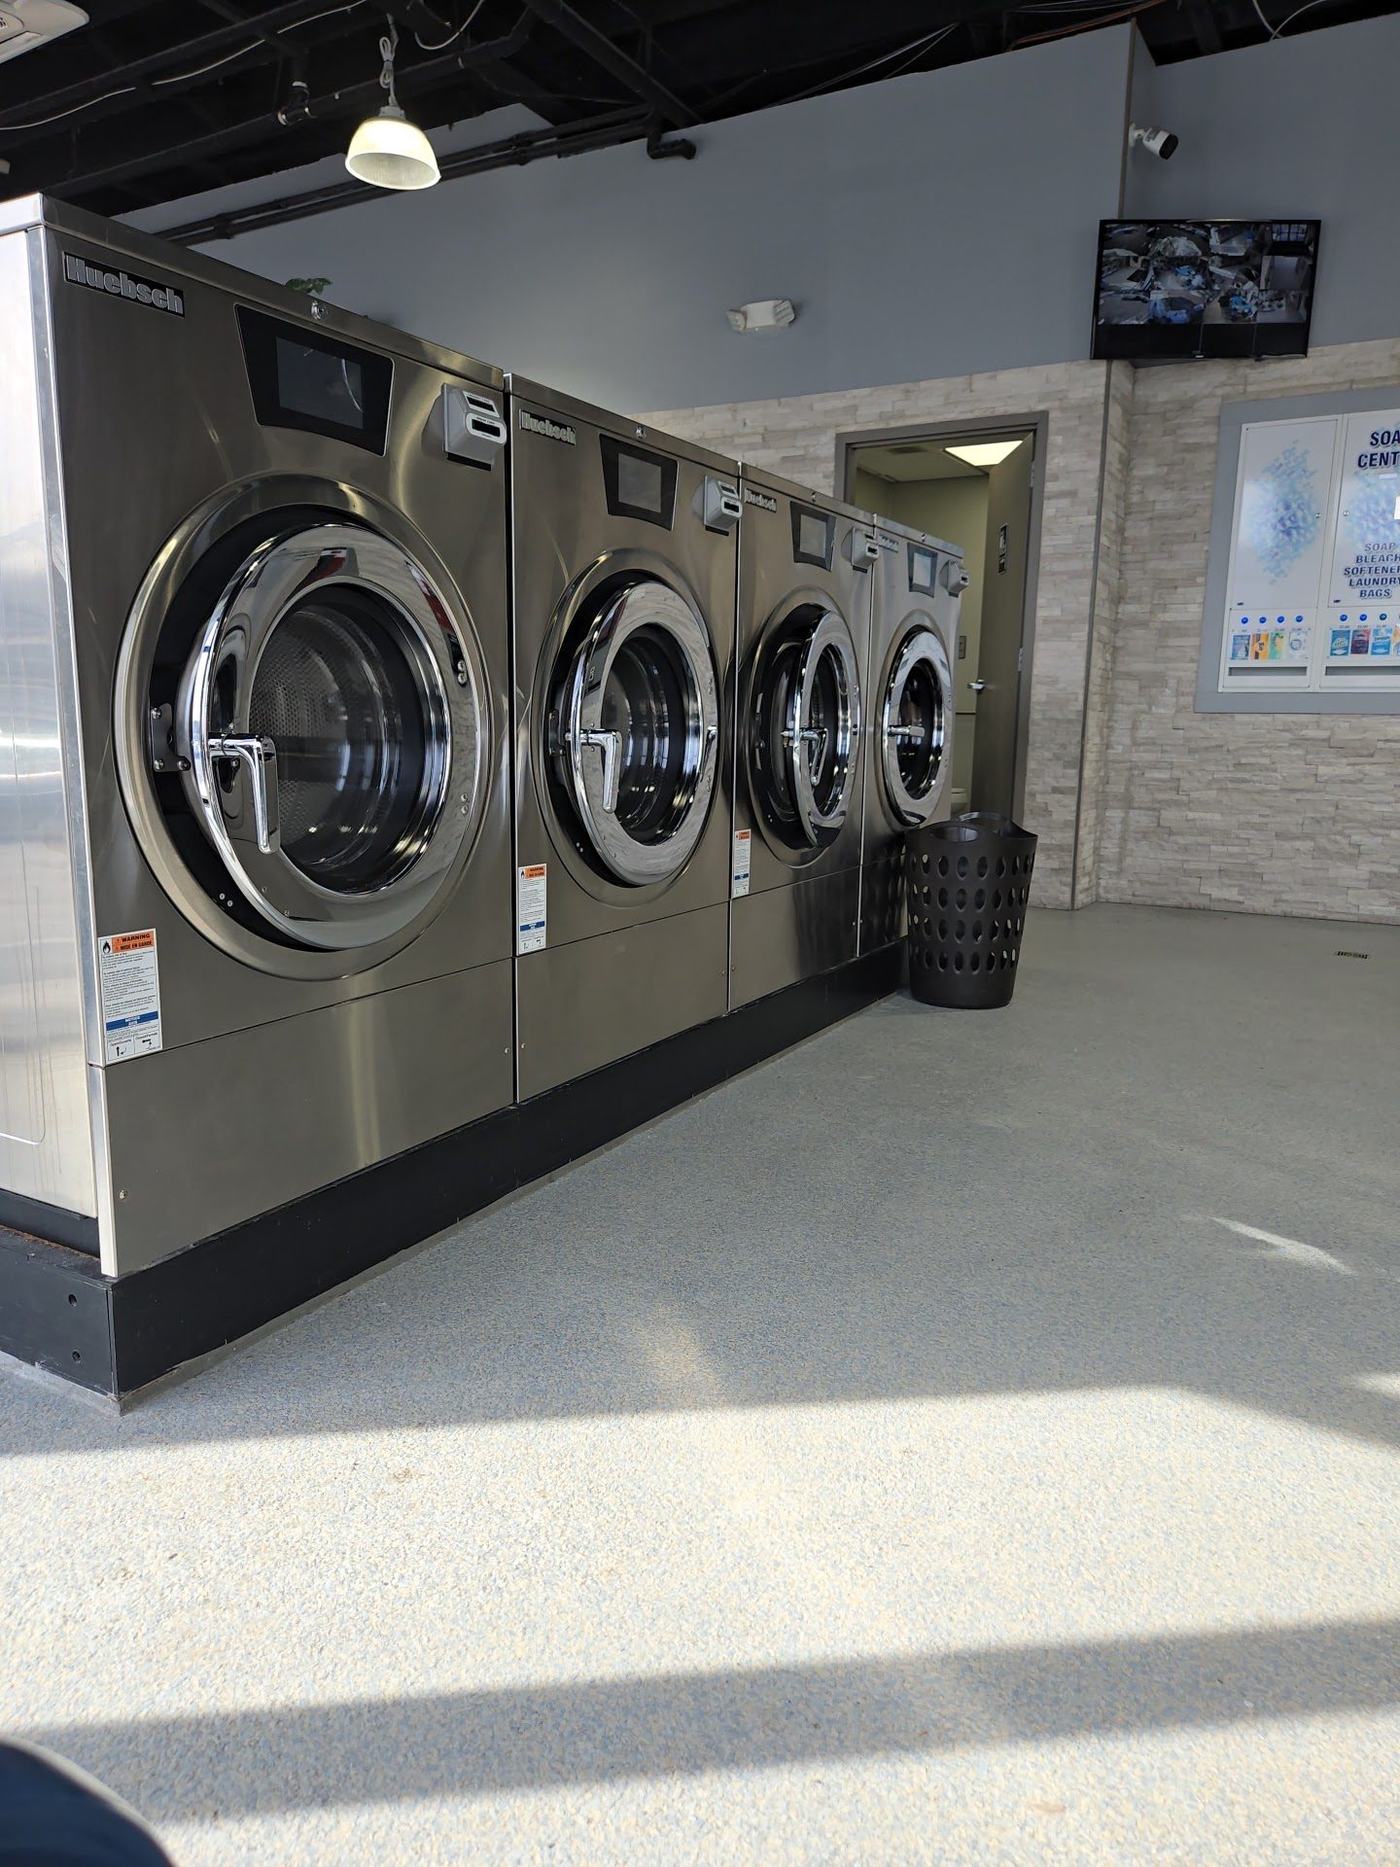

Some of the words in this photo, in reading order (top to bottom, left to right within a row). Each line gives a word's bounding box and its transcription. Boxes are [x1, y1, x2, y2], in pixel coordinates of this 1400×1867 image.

[66, 254, 184, 315] Huebsch
[521, 411, 576, 446] Huebsch
[1357, 451, 1400, 469] CENT
[1364, 542, 1396, 551] SOAP
[1359, 588, 1392, 598] BAGS
[121, 933, 151, 943] WARNING
